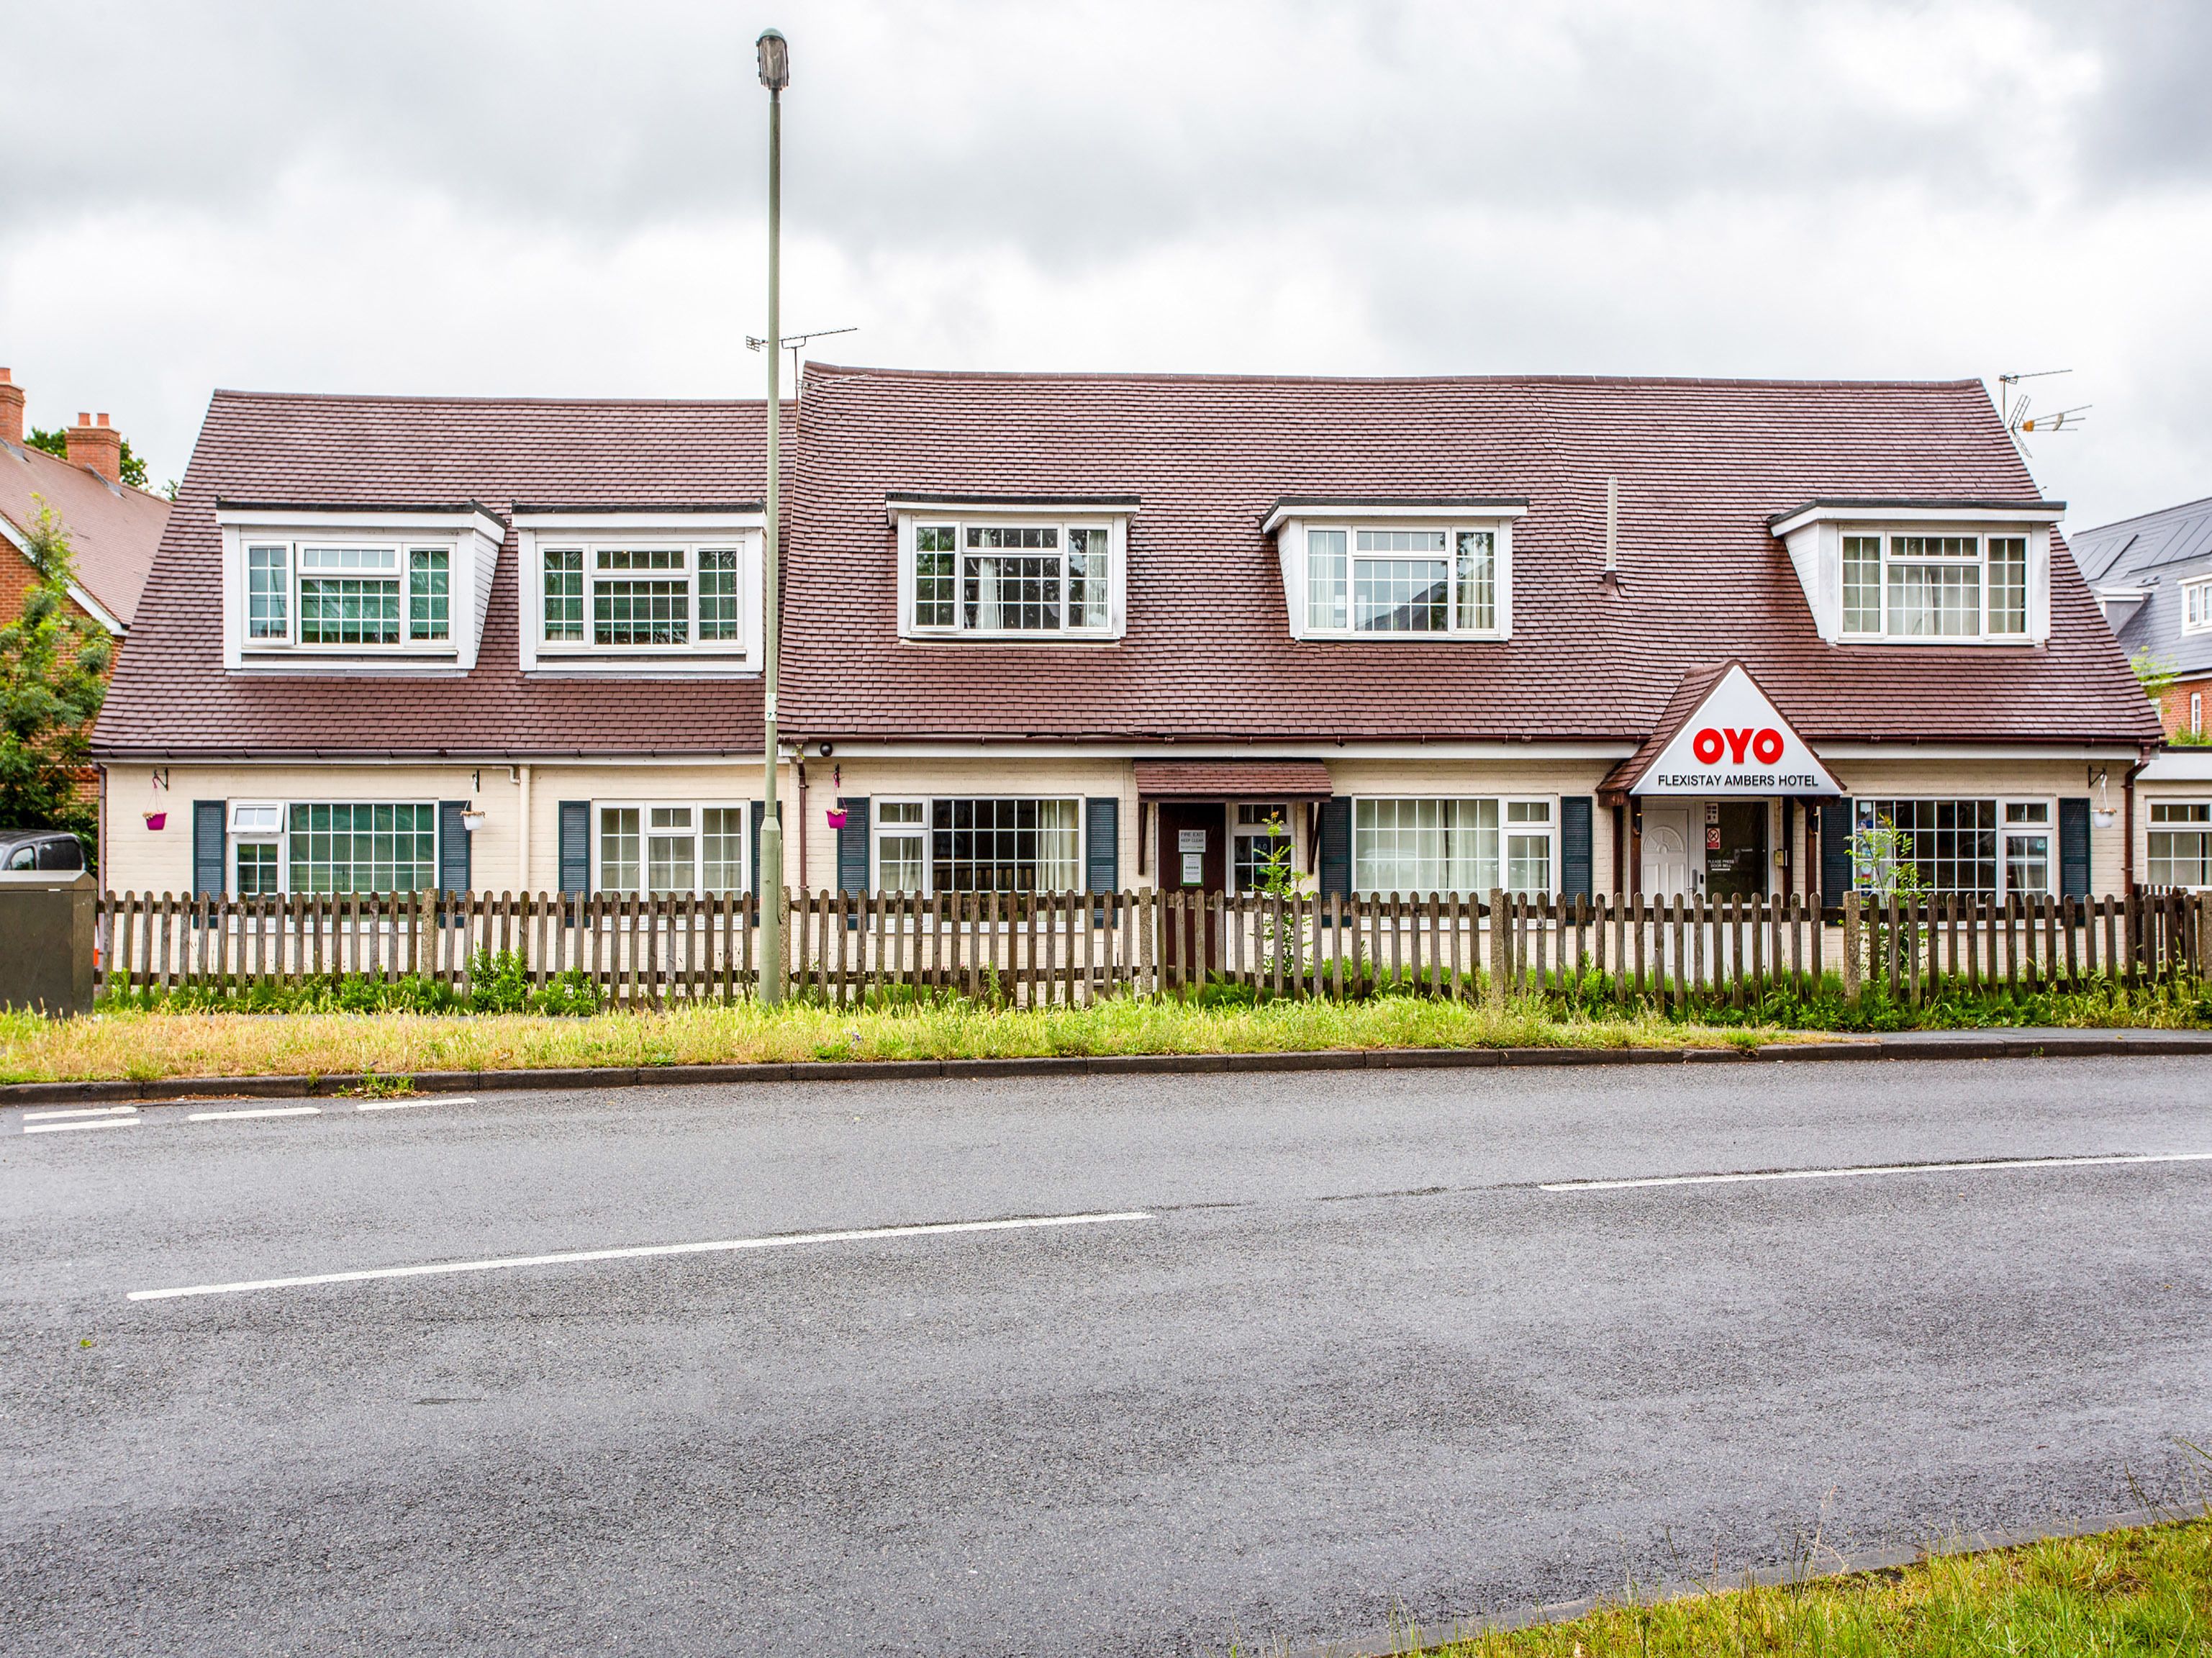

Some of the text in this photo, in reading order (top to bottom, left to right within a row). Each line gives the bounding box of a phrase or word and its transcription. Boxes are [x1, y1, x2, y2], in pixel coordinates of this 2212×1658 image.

[1693, 728, 1784, 765] OYO
[1658, 774, 1819, 787] FLEXISTAY AMBERS HOTEL
